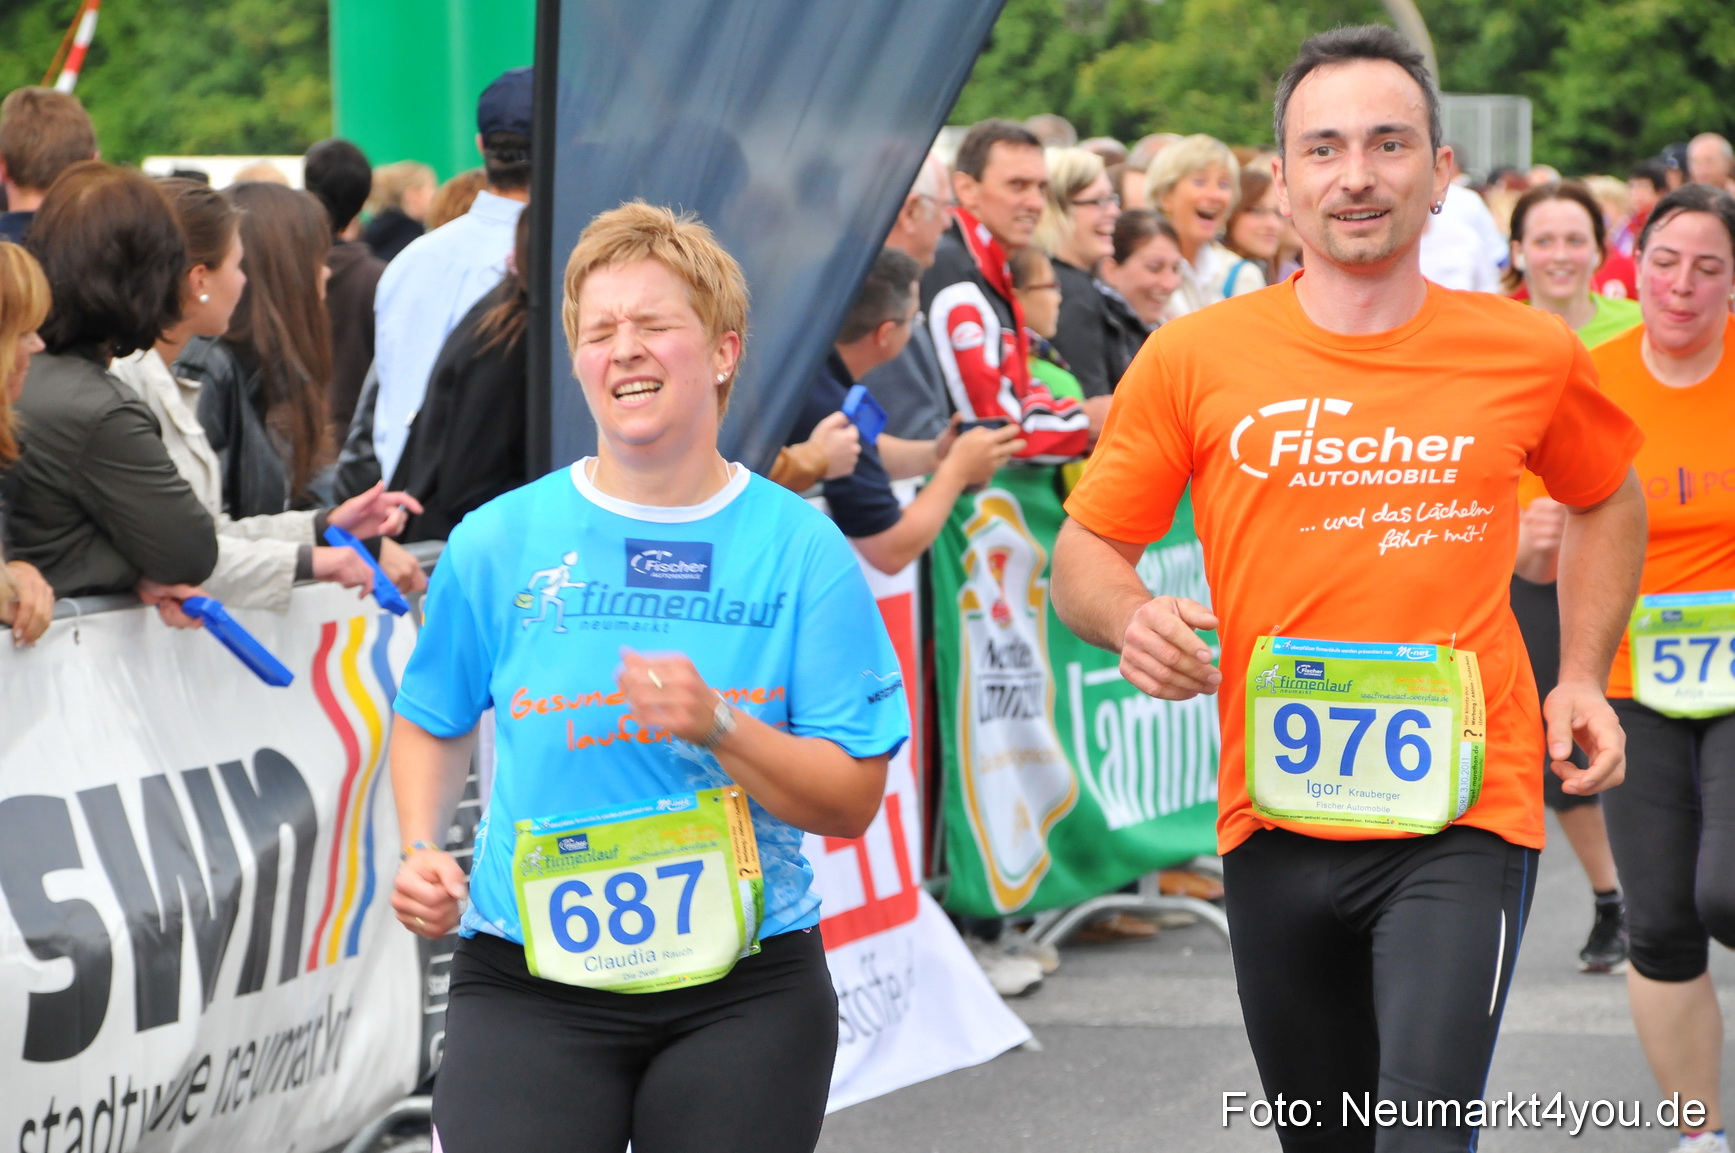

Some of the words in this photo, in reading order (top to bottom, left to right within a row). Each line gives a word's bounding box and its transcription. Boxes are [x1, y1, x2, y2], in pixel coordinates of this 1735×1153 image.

[1269, 426, 1475, 467] Fischer
[1288, 469, 1458, 487] AUTOMOBILE
[1324, 508, 1366, 530] und
[1371, 503, 1412, 524] das
[1378, 528, 1438, 556] fährt
[1444, 523, 1487, 543] mit!
[645, 559, 707, 574] Fischer
[581, 580, 787, 629] firmenlauf
[579, 619, 670, 634] neumarkt
[1653, 637, 1735, 684] 57
[1279, 675, 1353, 693] firmenlauf
[566, 713, 673, 751] laufen
[1273, 702, 1433, 782] 976
[1463, 729, 1483, 738] ?
[1460, 757, 1469, 793] 3.10.2011
[1306, 779, 1342, 799] Igor
[1348, 788, 1400, 801] Krauberger
[1316, 801, 1345, 810] Fischer
[1346, 802, 1391, 813] Automobile
[549, 859, 705, 953] 687
[584, 948, 657, 972] Claudia
[662, 947, 693, 960] Rauch
